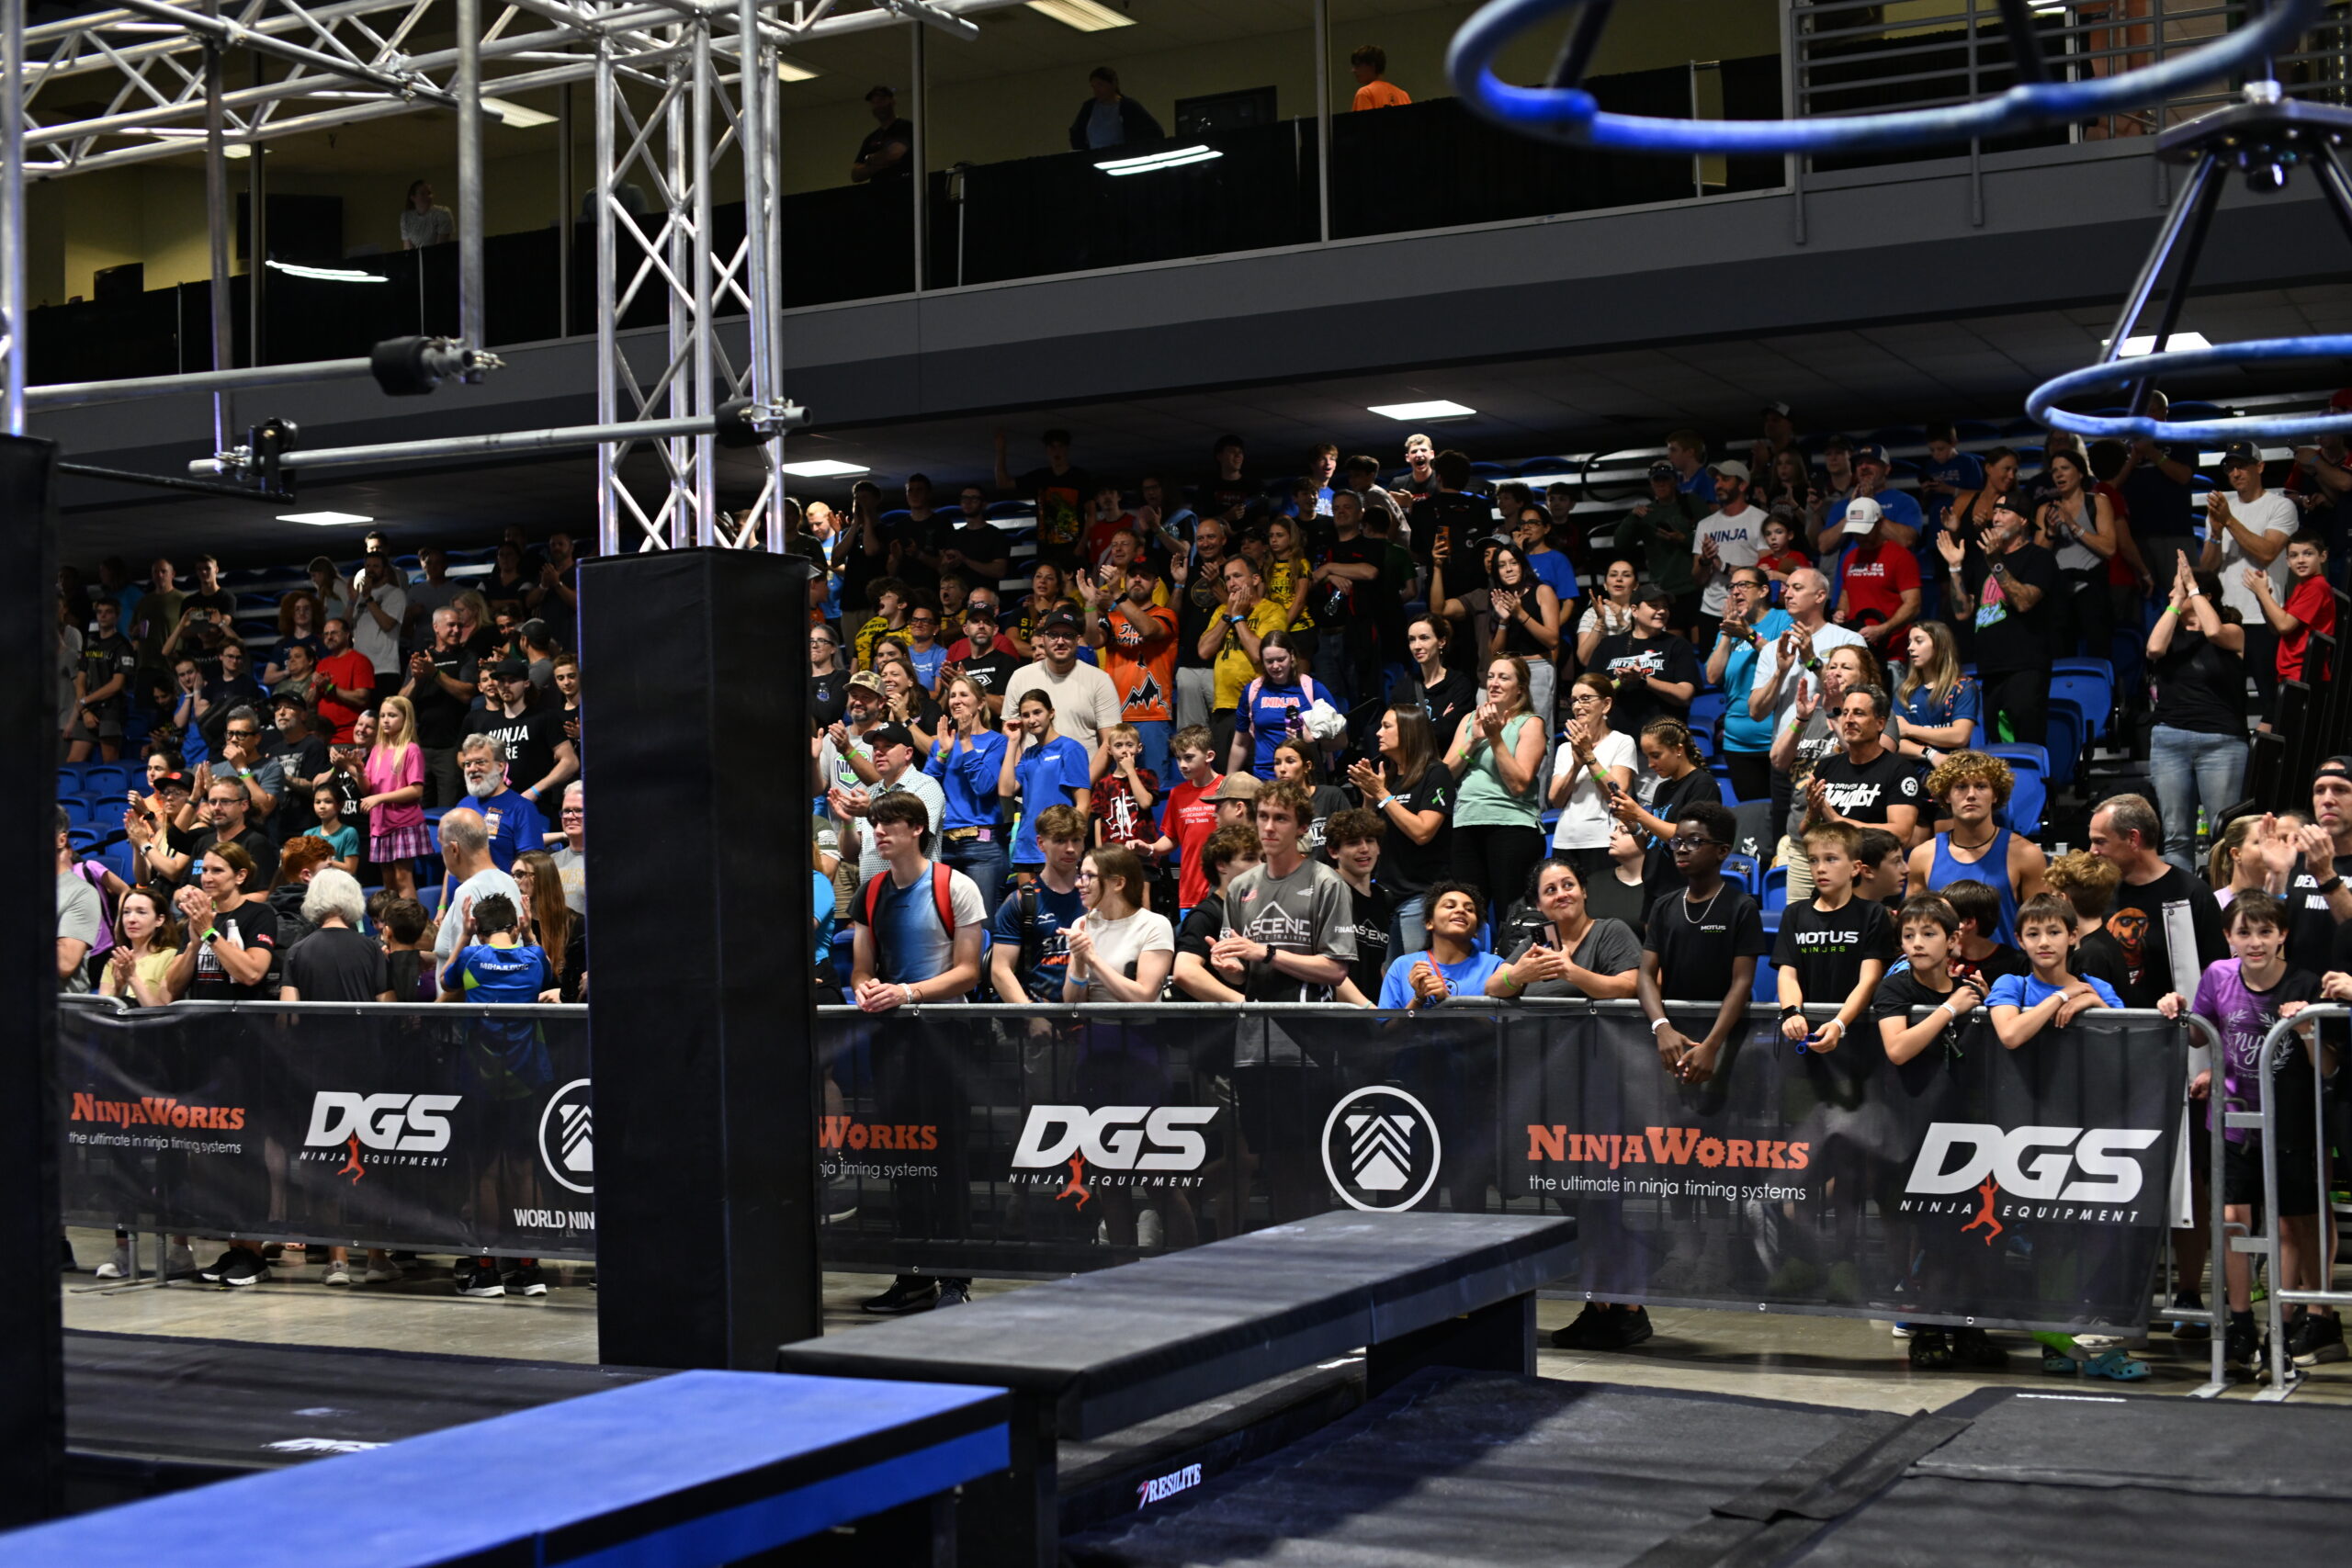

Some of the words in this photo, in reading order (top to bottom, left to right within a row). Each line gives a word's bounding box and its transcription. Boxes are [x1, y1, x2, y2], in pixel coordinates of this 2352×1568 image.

[1710, 528, 1747, 542] NINJA
[1608, 658, 1664, 670] HITSUAD
[304, 1091, 462, 1152] DGS
[69, 1131, 87, 1145] the
[89, 1133, 130, 1147] ultimate
[132, 1134, 141, 1146] in
[143, 1135, 168, 1151] ninja
[171, 1136, 200, 1154] timing
[201, 1142, 242, 1155] systems
[1011, 1105, 1220, 1170] DGS
[300, 1151, 346, 1163] NINJA
[364, 1154, 448, 1168] EQUIPMENT
[840, 1161, 880, 1179] timing
[884, 1162, 938, 1179] systems
[1904, 1122, 2163, 1203] DGS
[1009, 1173, 1065, 1185] NINJA
[1089, 1175, 1204, 1187] EQUIPMENT
[1529, 1175, 1556, 1190] the
[1560, 1176, 1620, 1192] ultimate
[1623, 1177, 1635, 1192] in
[1639, 1178, 1679, 1198] ninja
[1684, 1179, 1736, 1201] timing
[1741, 1182, 1806, 1201] systems
[514, 1208, 565, 1229] WORLD
[1899, 1200, 1972, 1214] NINJA
[2002, 1204, 2139, 1223] EQUIPMENT
[1148, 1463, 1202, 1503] RESILITE
